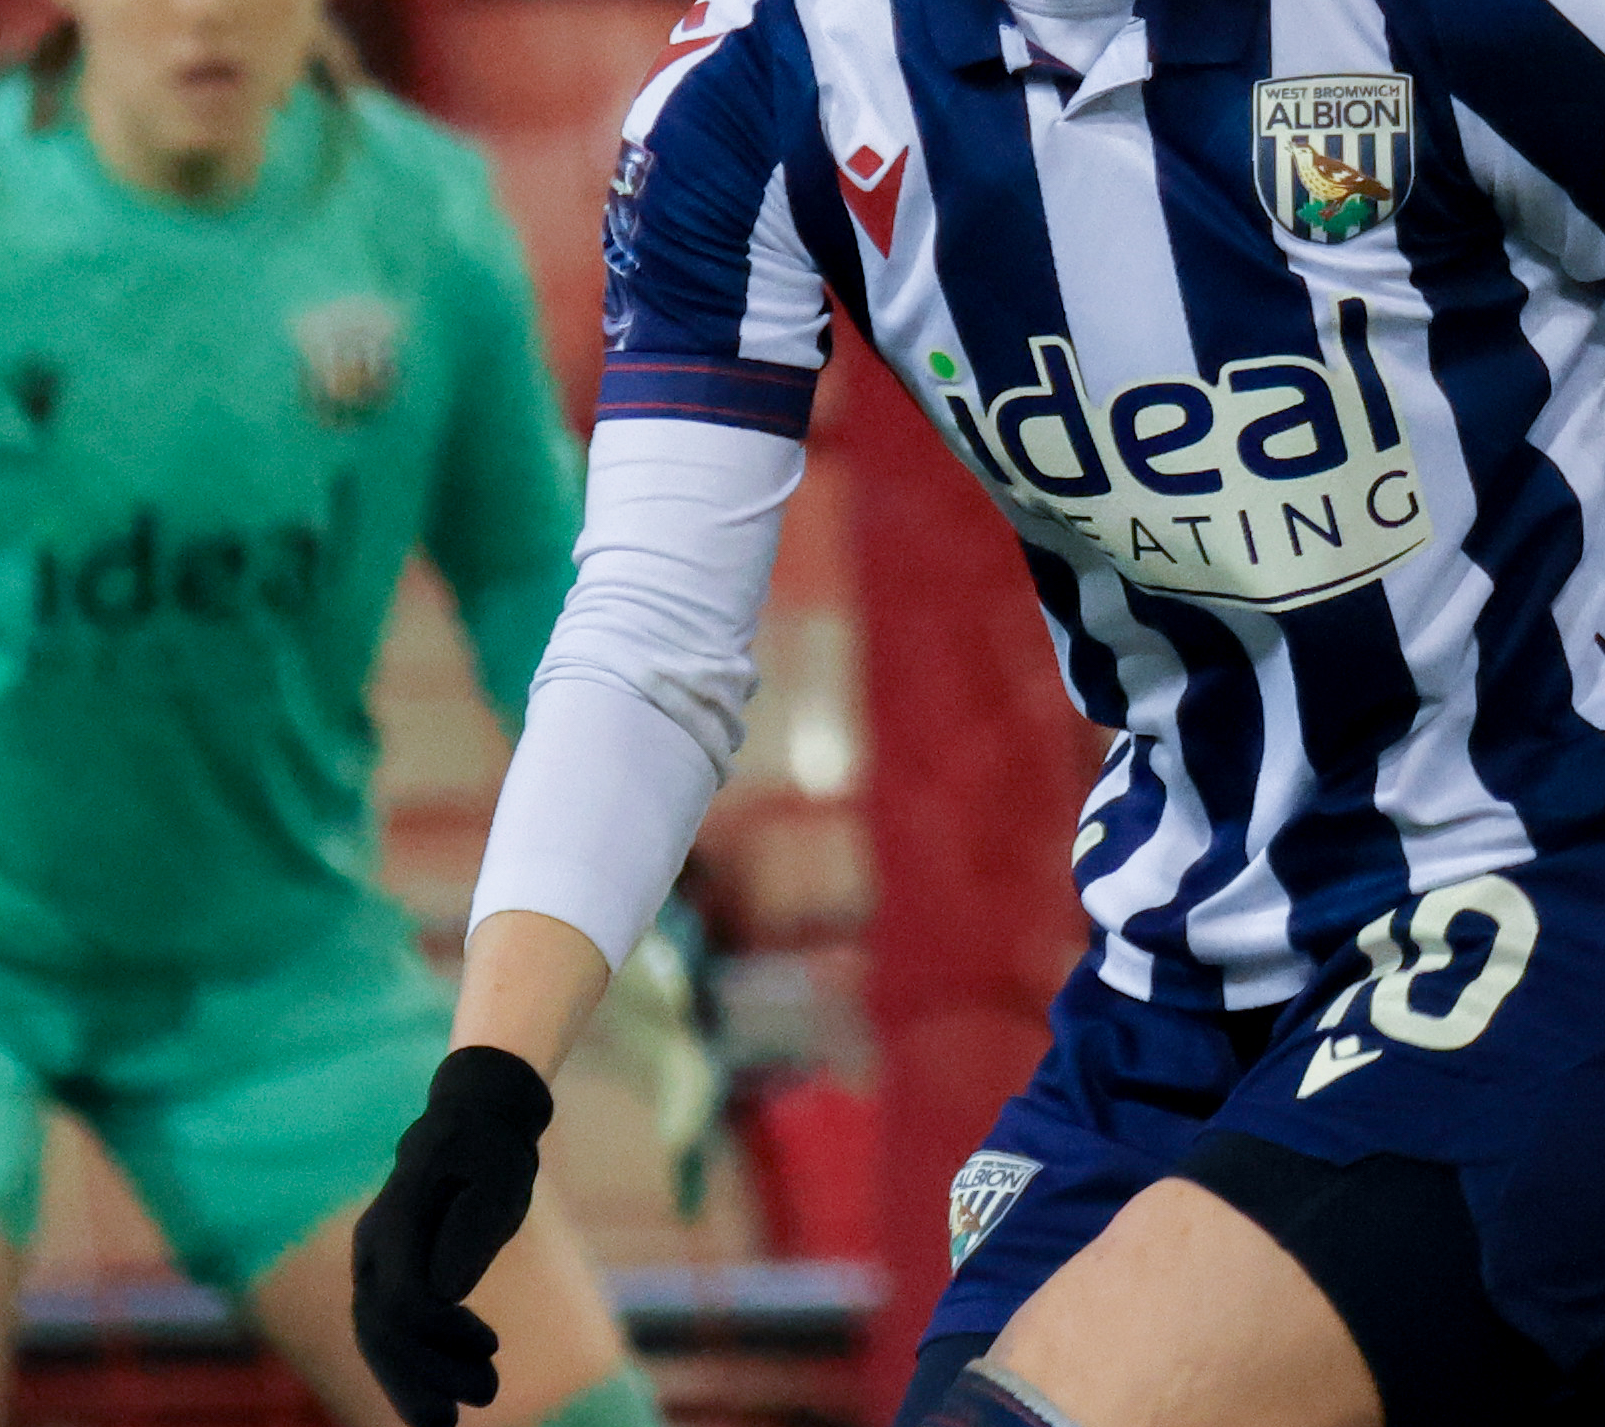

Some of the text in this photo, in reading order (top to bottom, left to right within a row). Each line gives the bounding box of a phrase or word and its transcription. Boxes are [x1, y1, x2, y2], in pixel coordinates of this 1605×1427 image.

[1265, 84, 1400, 100] WEST BROMWICH
[1265, 99, 1401, 131] ALBION
[928, 296, 1401, 498] ideal
[1054, 468, 1421, 567] EATING
[954, 1168, 1026, 1190] ALBION
